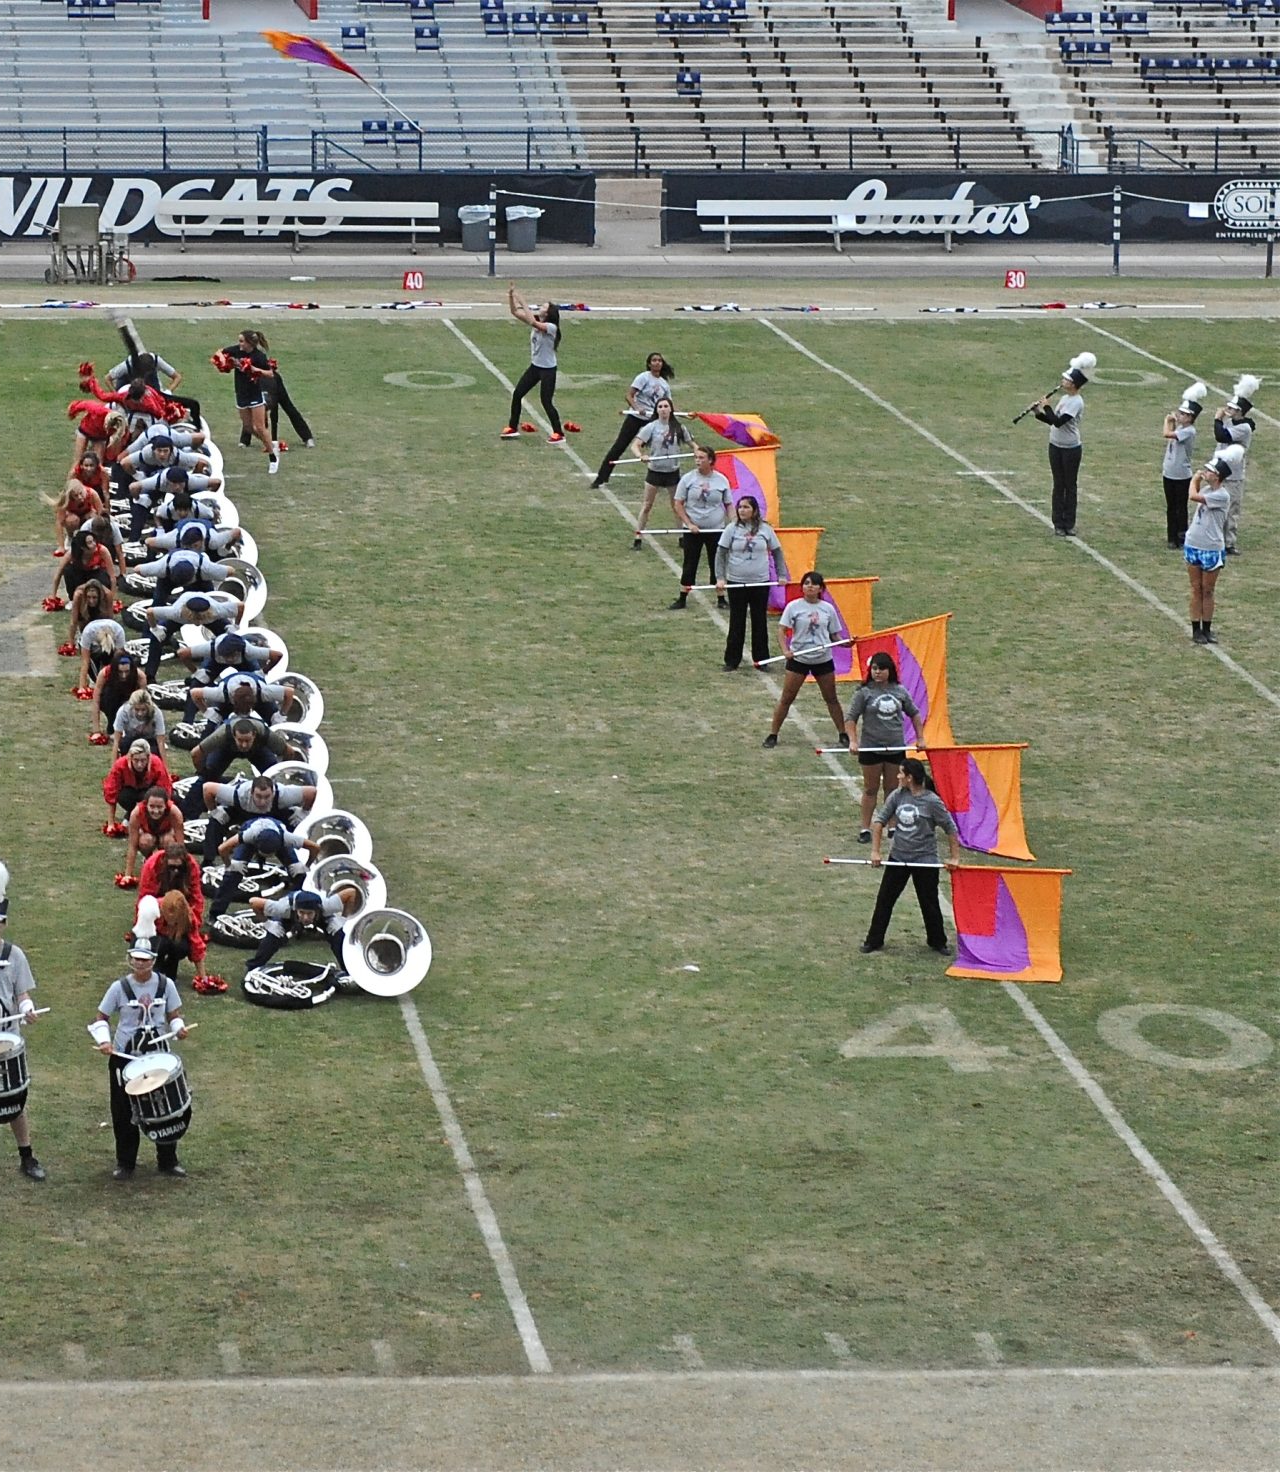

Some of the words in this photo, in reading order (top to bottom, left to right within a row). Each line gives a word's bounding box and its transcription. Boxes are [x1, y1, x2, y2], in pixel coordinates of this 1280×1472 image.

[405, 272, 423, 289] 40
[1007, 271, 1025, 288] 30
[156, 1120, 187, 1138] YAMAHA
